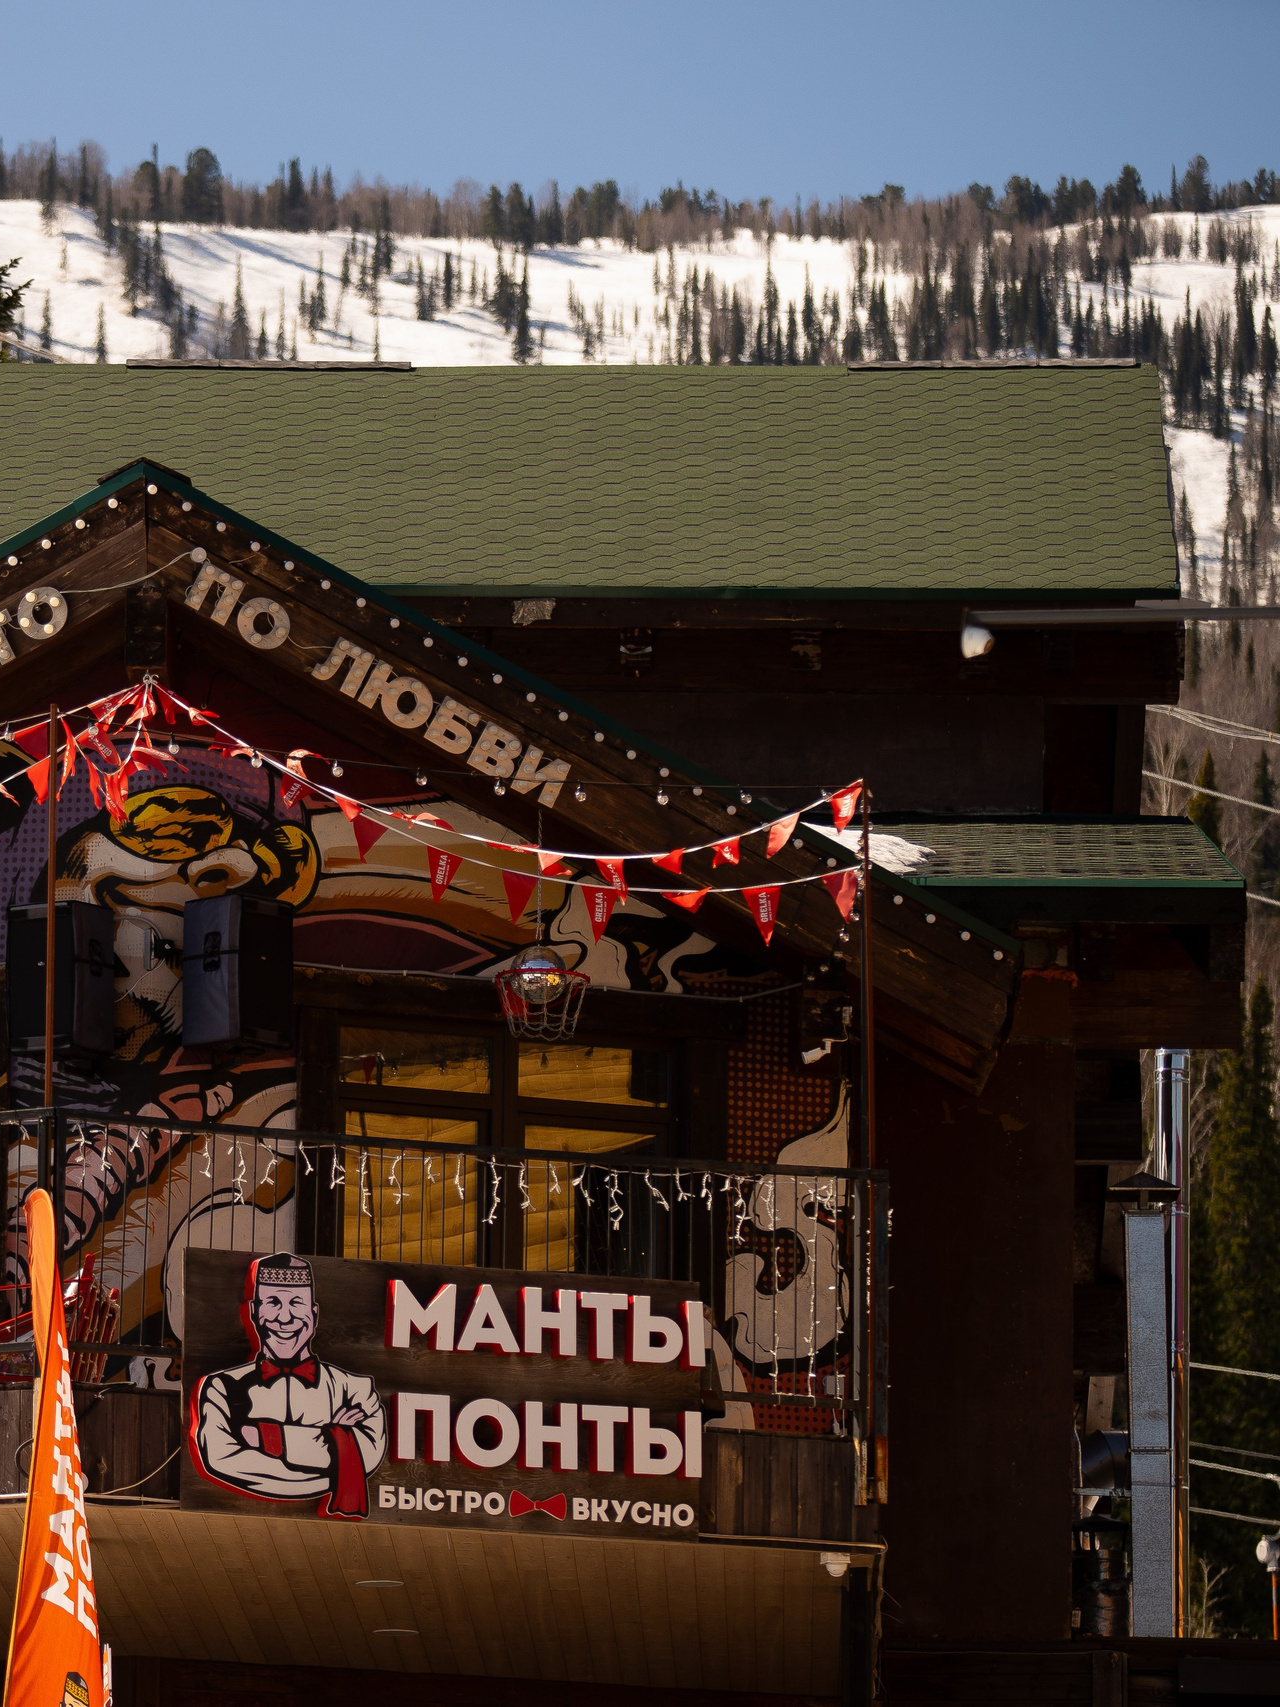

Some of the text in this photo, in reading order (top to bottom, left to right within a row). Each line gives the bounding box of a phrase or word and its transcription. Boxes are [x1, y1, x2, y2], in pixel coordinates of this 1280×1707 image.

[185, 562, 572, 808] ПО ЛЮБВИ
[435, 854, 448, 885] GRELKA
[595, 892, 604, 923] GRELKA
[758, 892, 769, 923] GRELKA
[386, 1279, 707, 1369] МАНТЫ
[390, 1391, 703, 1478] ПОНТЫ
[41, 1331, 76, 1616] МАНТЫ
[379, 1485, 696, 1529] БЫСТРО ВКУСНО
